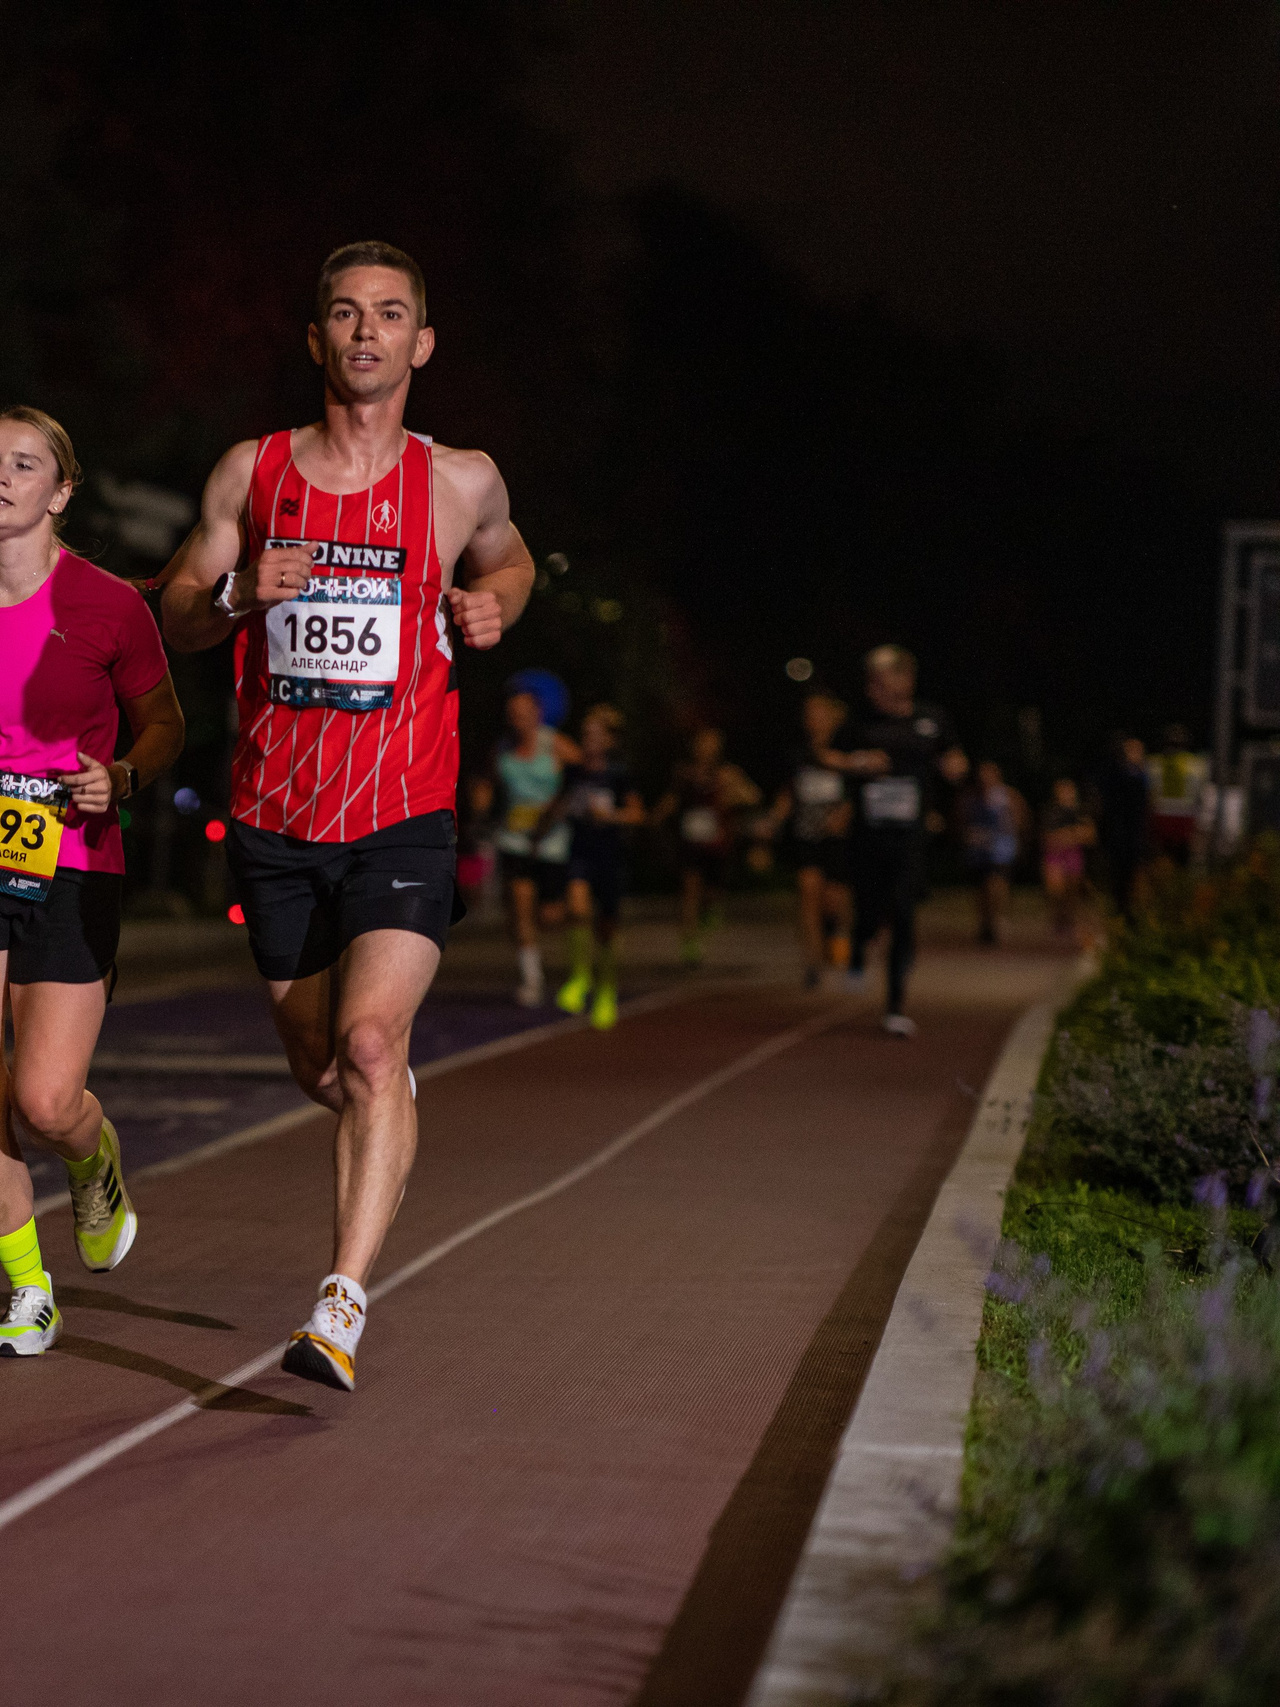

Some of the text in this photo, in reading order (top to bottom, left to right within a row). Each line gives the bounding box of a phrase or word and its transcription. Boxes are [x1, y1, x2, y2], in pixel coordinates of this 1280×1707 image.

[331, 545, 400, 570] NINE
[299, 577, 391, 600] ОЧНОЙ
[284, 613, 382, 656] 1856
[291, 657, 368, 673] АЛЕКСАНДР
